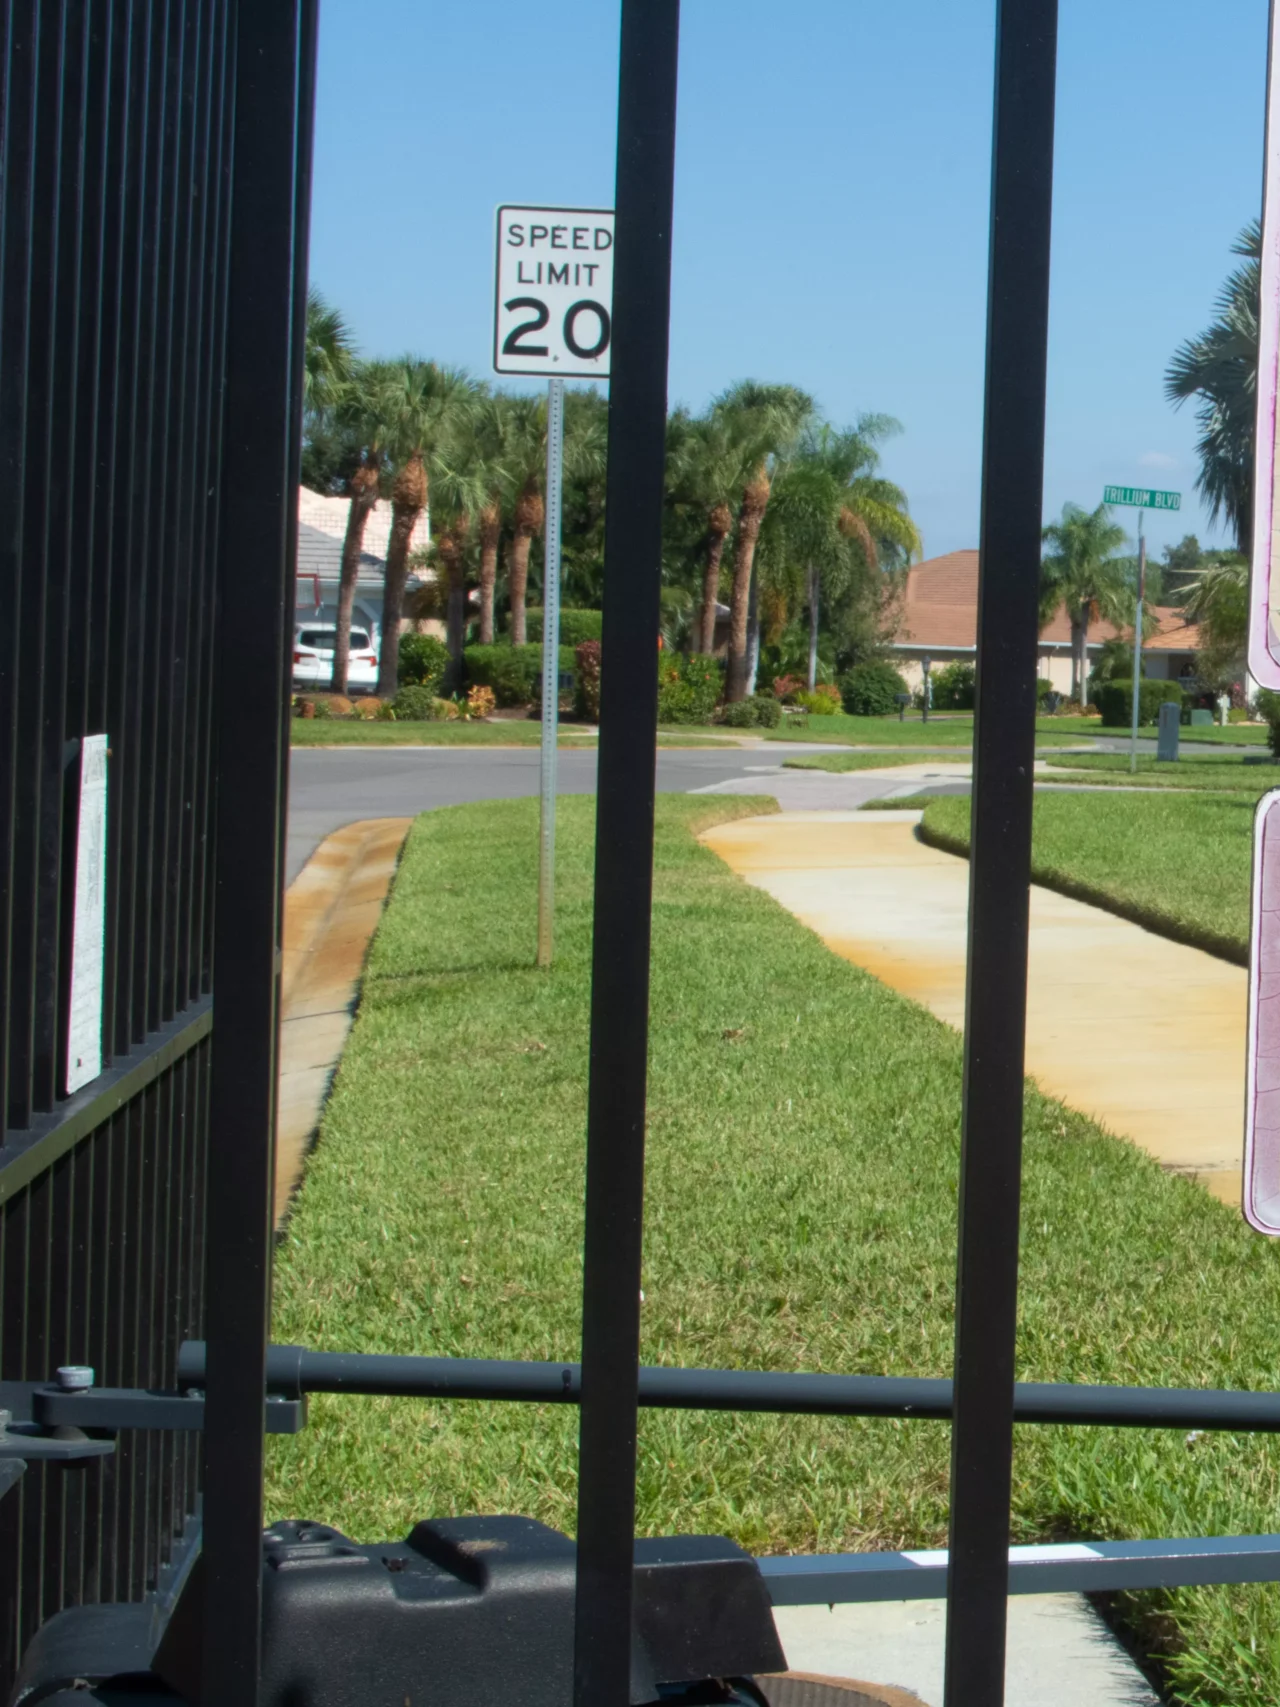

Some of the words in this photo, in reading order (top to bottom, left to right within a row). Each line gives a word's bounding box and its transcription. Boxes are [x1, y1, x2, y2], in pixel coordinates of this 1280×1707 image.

[507, 224, 612, 251] SPEED
[517, 261, 599, 287] LIMIT
[502, 297, 611, 359] 20
[1104, 487, 1150, 507] TRILLIUM
[1155, 492, 1180, 510] BLVD
